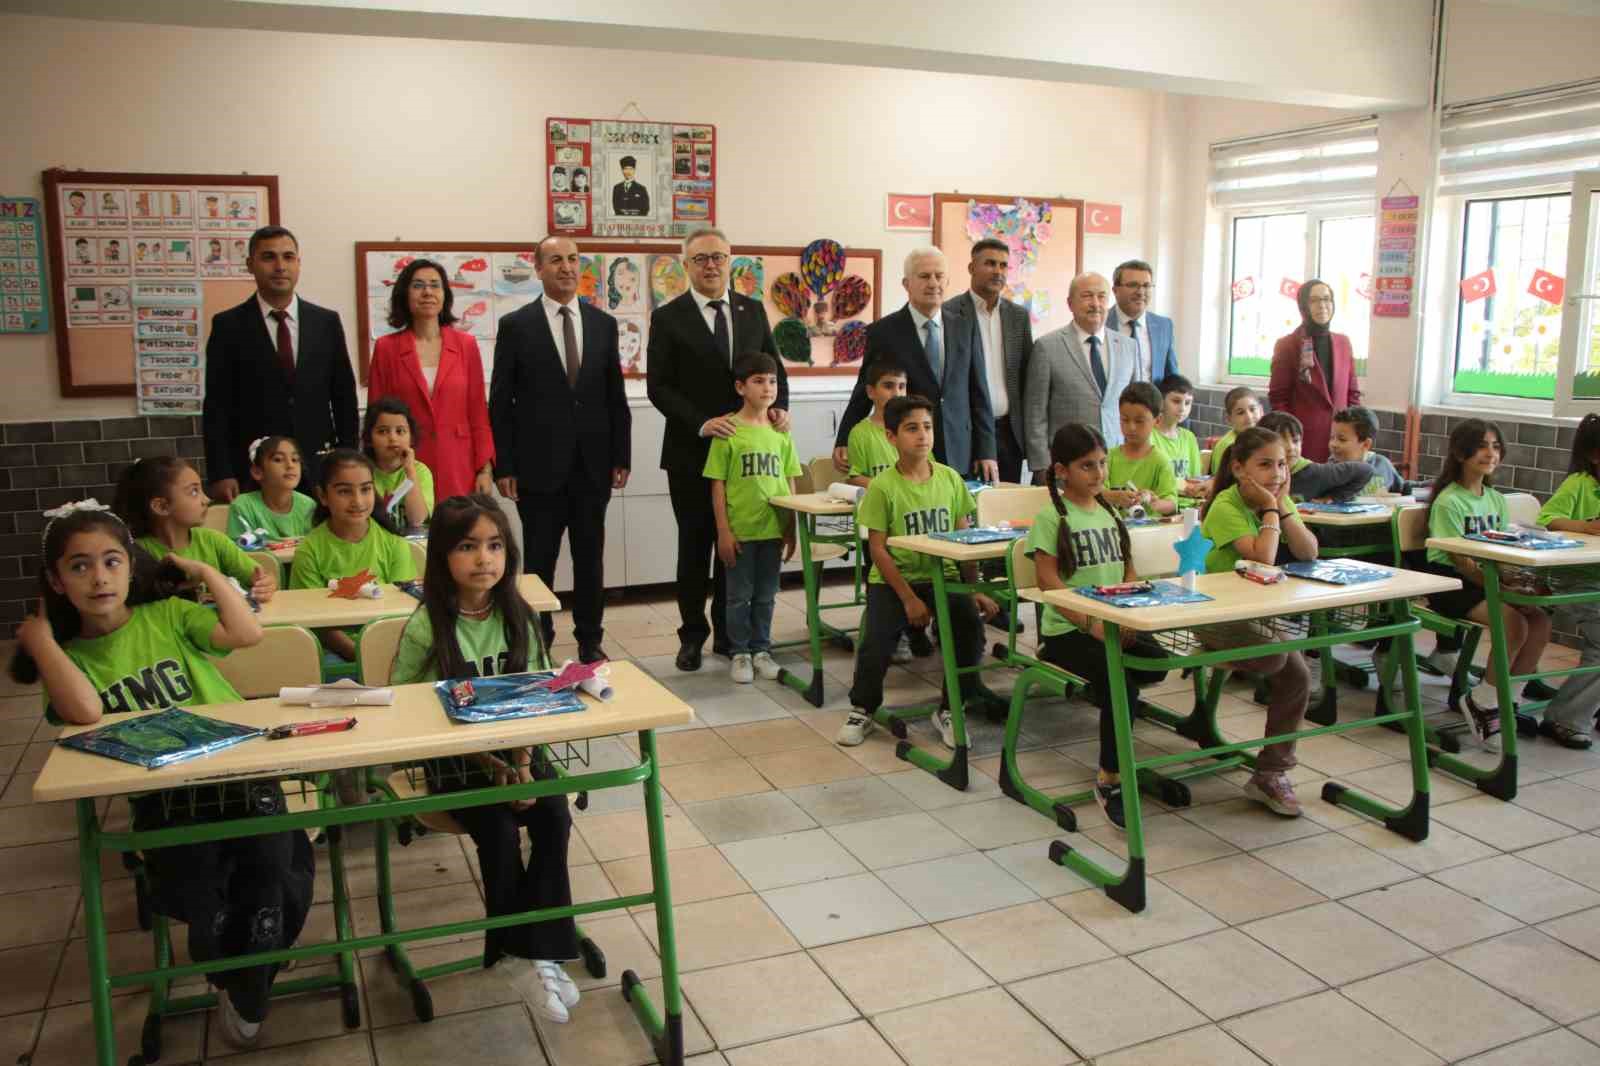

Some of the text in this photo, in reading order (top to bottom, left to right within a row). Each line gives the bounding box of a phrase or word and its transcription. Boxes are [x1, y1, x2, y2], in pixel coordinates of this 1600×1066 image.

[146, 340, 194, 348] WEDNESDAY
[150, 356, 191, 364] THURSDAY
[153, 401, 184, 409] SUNDAY
[741, 452, 780, 478] HMG
[904, 508, 950, 536] HMG
